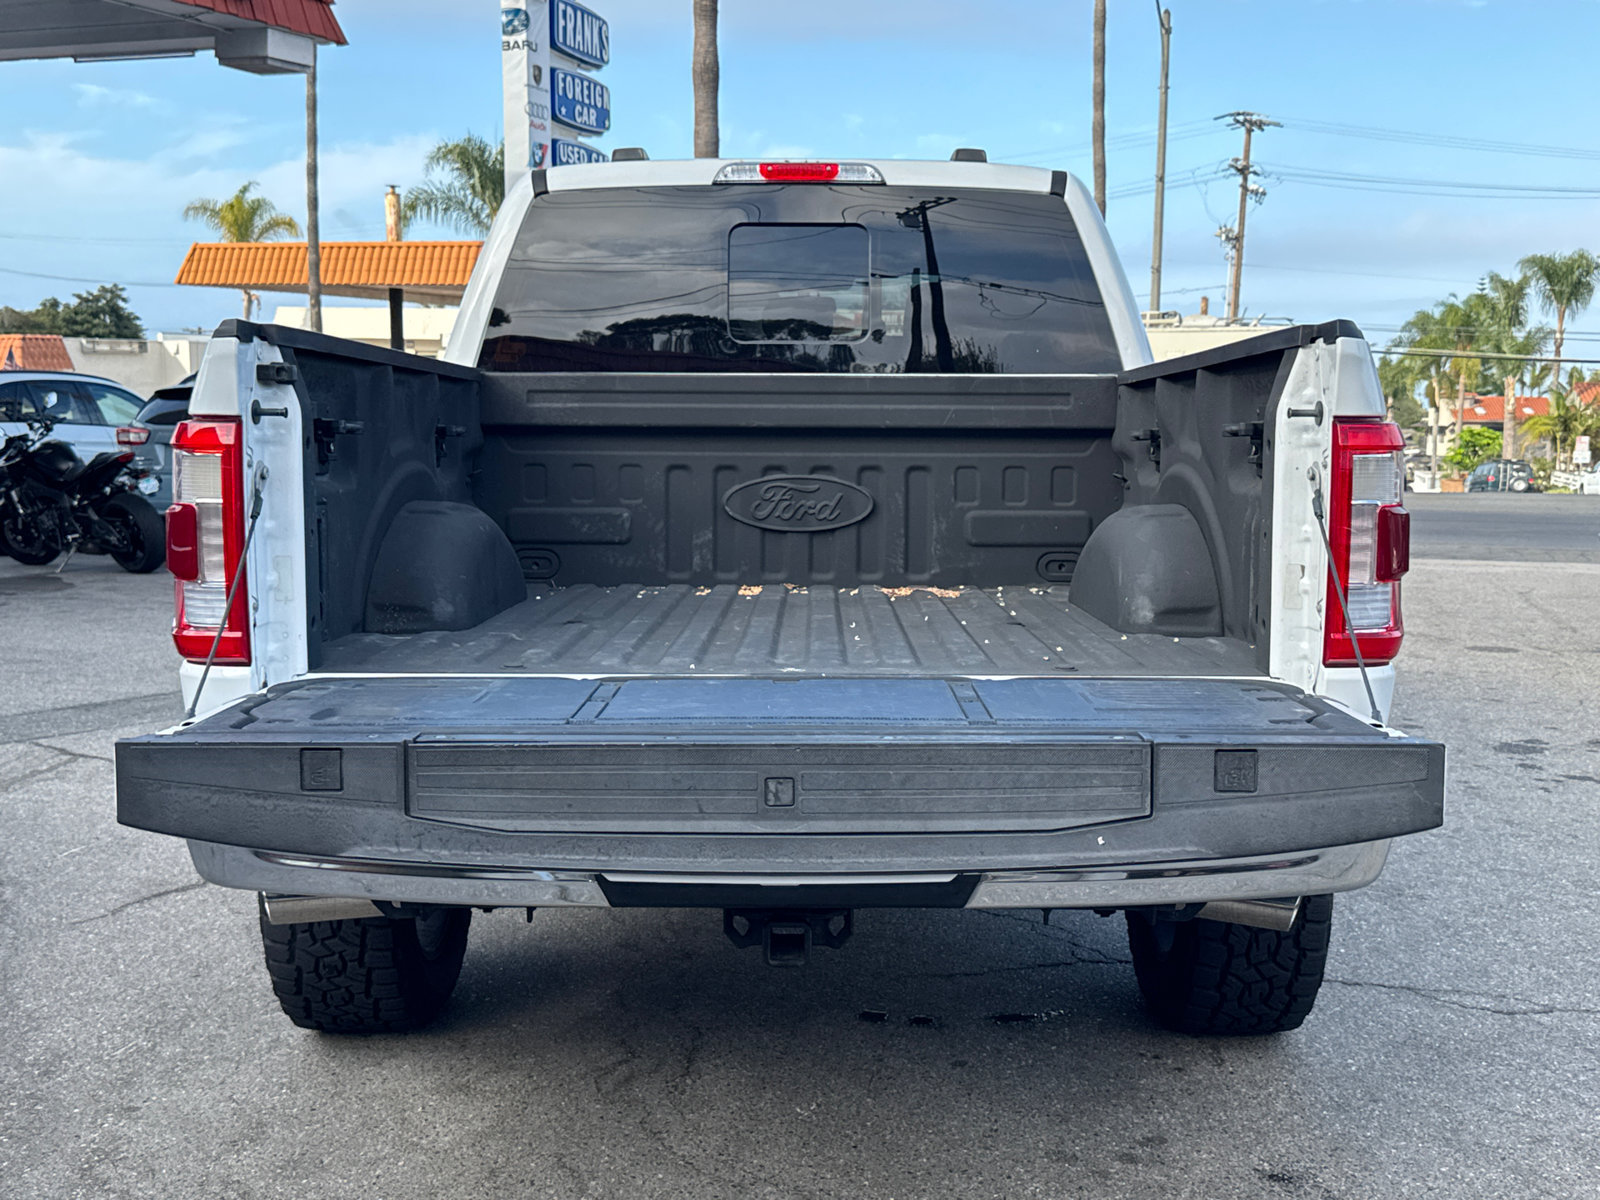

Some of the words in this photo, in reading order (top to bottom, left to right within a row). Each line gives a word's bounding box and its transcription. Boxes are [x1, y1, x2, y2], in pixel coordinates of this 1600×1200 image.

[502, 39, 538, 53] BARU
[558, 2, 609, 62] FRANK'S
[558, 72, 610, 109] FOREIGN
[574, 104, 597, 127] CAR
[559, 143, 588, 164] USED
[751, 482, 844, 522] Ford
